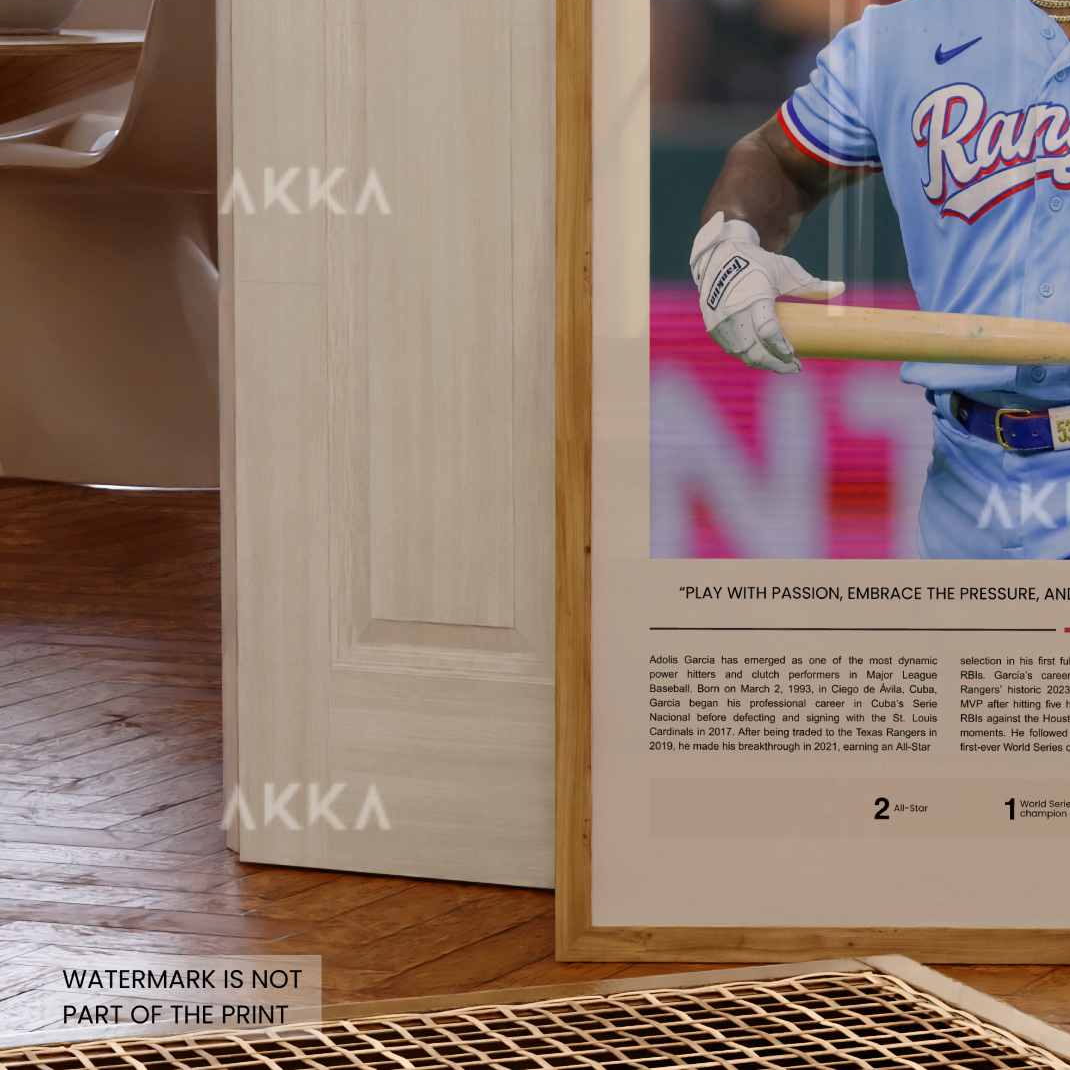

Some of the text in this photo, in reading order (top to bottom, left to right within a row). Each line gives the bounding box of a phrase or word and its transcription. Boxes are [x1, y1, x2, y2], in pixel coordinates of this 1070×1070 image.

[679, 586, 722, 599] “PLAY
[727, 587, 766, 599] WITH
[772, 586, 843, 602] PASSION,
[848, 587, 922, 600] EMBRACE
[927, 587, 955, 600] THE
[960, 587, 1039, 602] PRESSURE,
[649, 655, 678, 664] Adolis
[684, 655, 715, 664] García
[721, 655, 738, 664] has
[744, 656, 785, 666] emerged
[832, 656, 842, 664] of
[848, 656, 863, 664] the
[898, 656, 938, 667] dynamic
[960, 656, 1001, 665] selection
[1007, 656, 1015, 665] in
[1020, 656, 1033, 665] his
[1038, 656, 1055, 665] first
[874, 797, 928, 820] 2 All-Star
[1005, 798, 1015, 820] 1
[1020, 800, 1046, 808] World
[1020, 809, 1067, 819] champion
